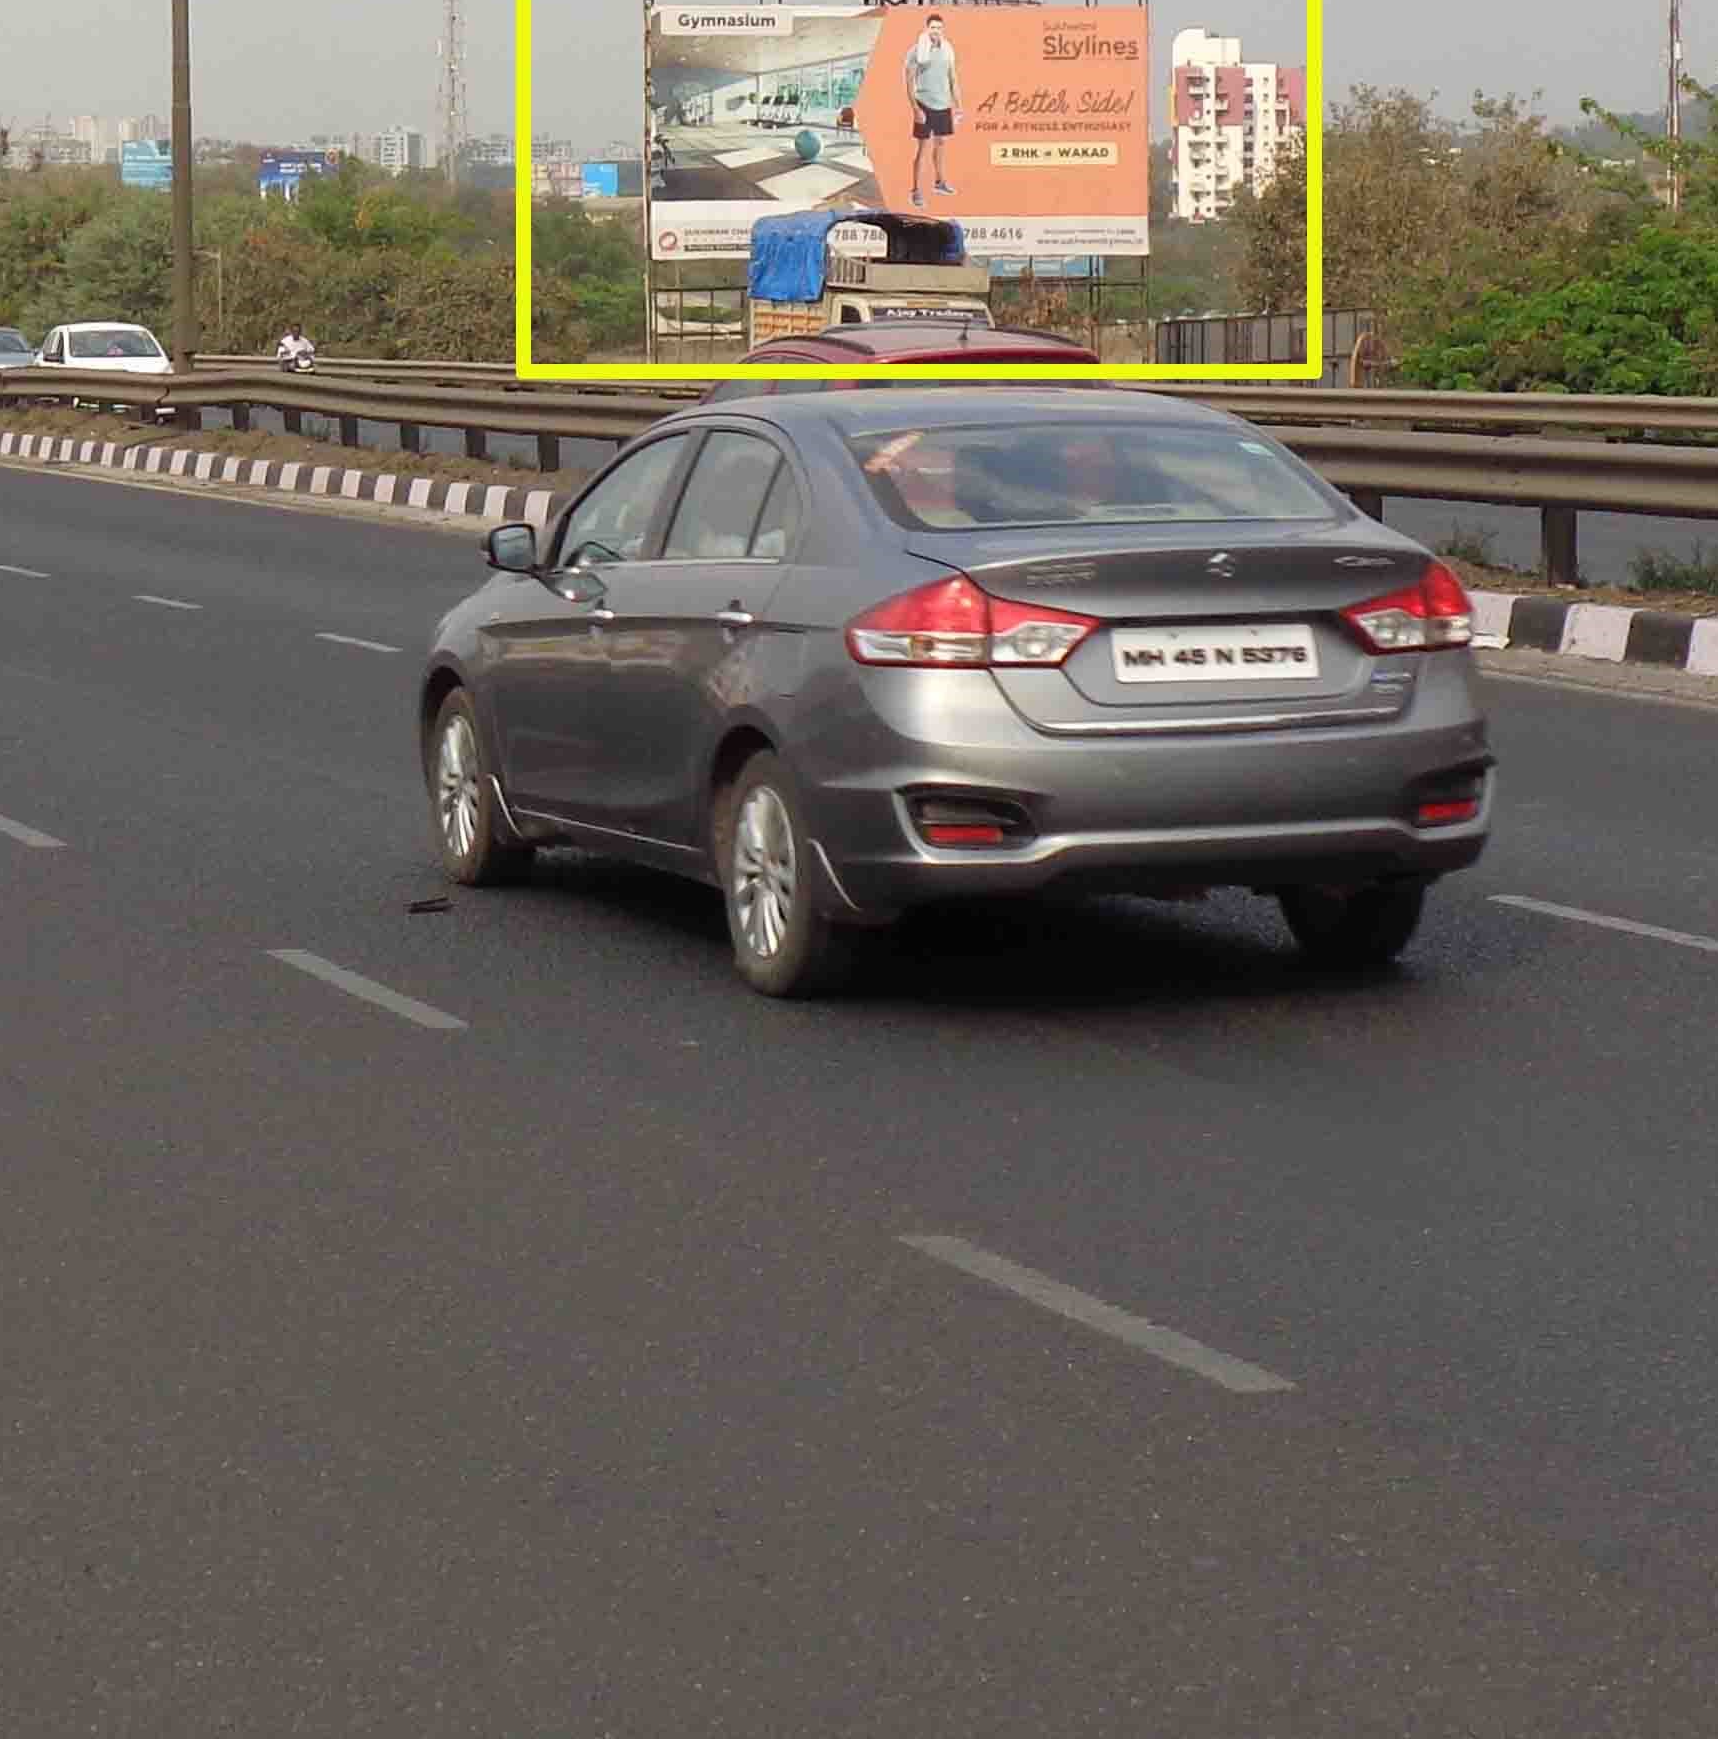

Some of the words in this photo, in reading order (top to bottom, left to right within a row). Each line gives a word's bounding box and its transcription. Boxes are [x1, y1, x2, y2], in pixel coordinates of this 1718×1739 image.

[678, 13, 776, 29] Gymnasium
[1043, 34, 1139, 60] Skylines
[1003, 87, 1070, 114] Better
[975, 121, 998, 132] FOR
[1001, 147, 1009, 159] 2
[1058, 147, 1109, 158] WAKAD
[1123, 649, 1164, 666] MH
[1215, 647, 1234, 662] N
